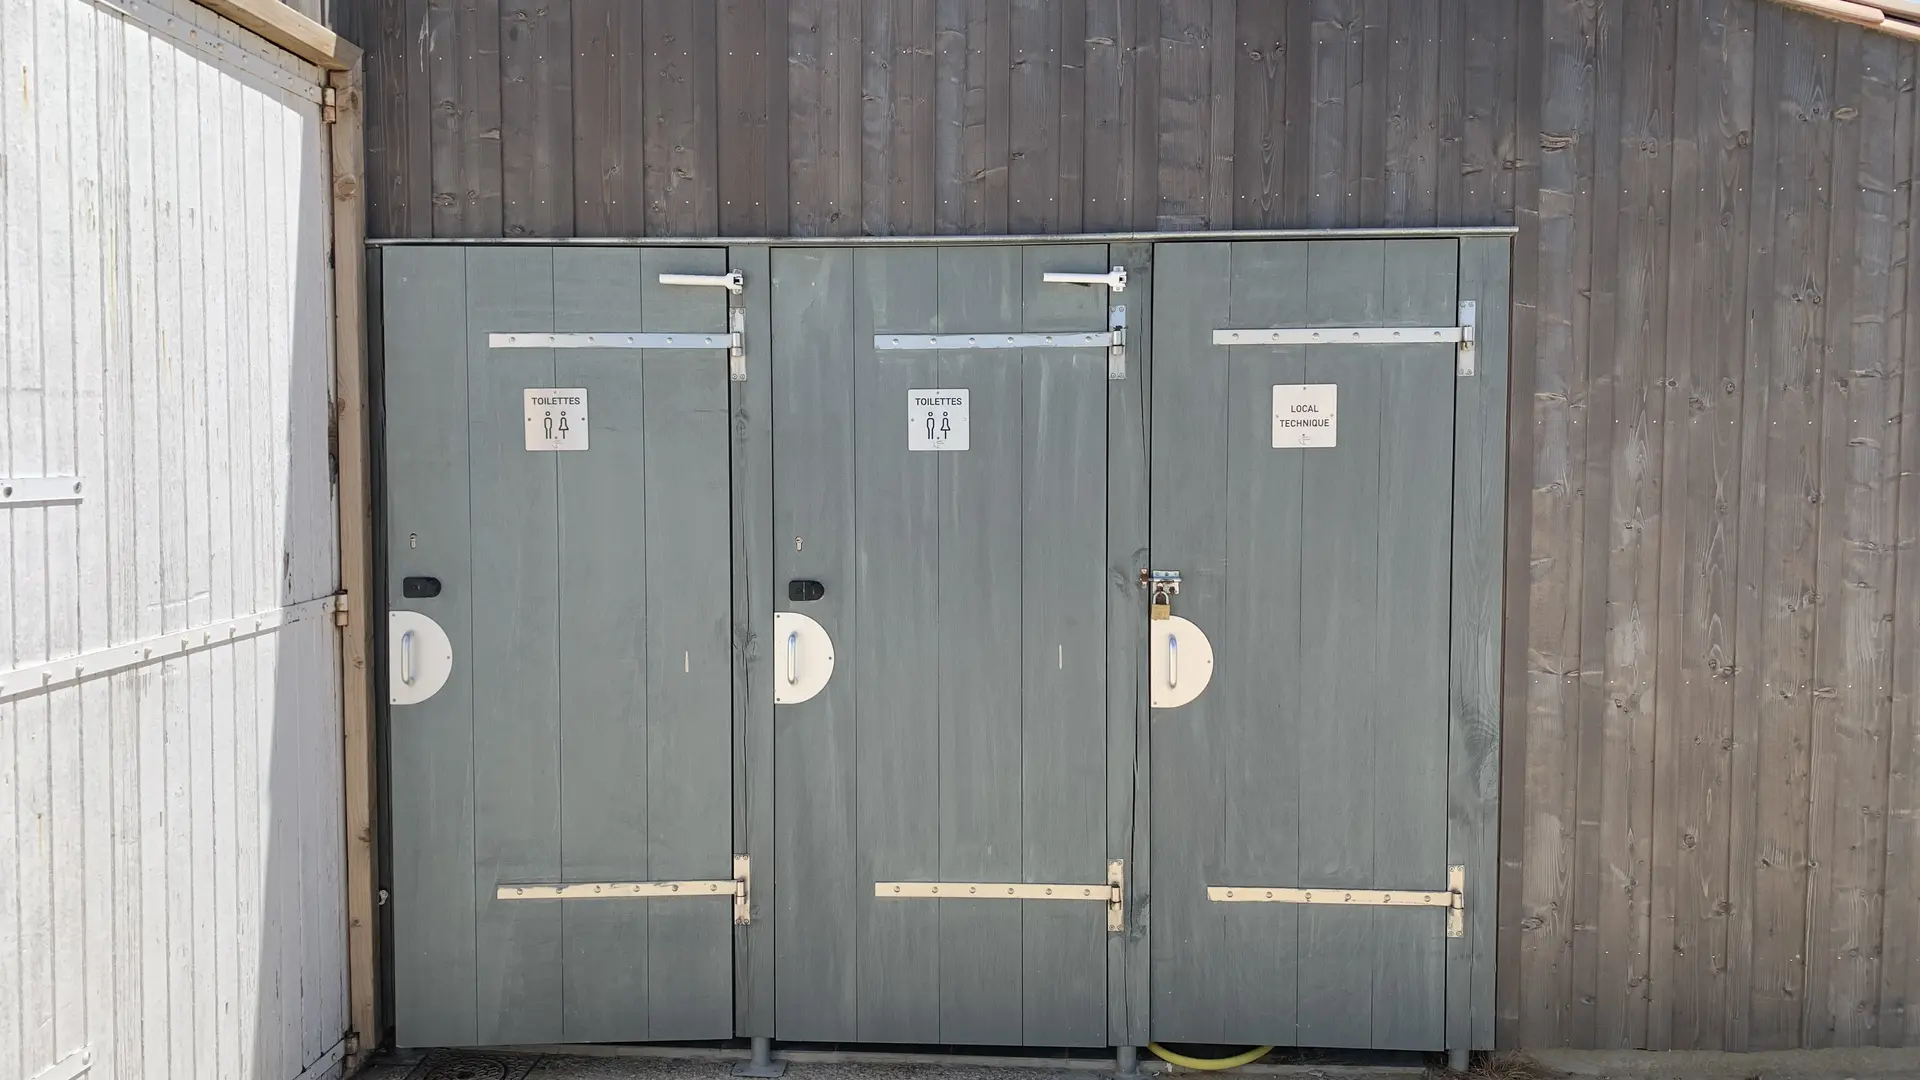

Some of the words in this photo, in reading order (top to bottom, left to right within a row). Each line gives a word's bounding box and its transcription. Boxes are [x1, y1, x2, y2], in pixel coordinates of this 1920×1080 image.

[531, 397, 581, 405] TOILETTES
[915, 397, 963, 406] TOILETTES
[1290, 404, 1319, 413] LOCAL
[1279, 419, 1330, 428] TECHNIQUE
